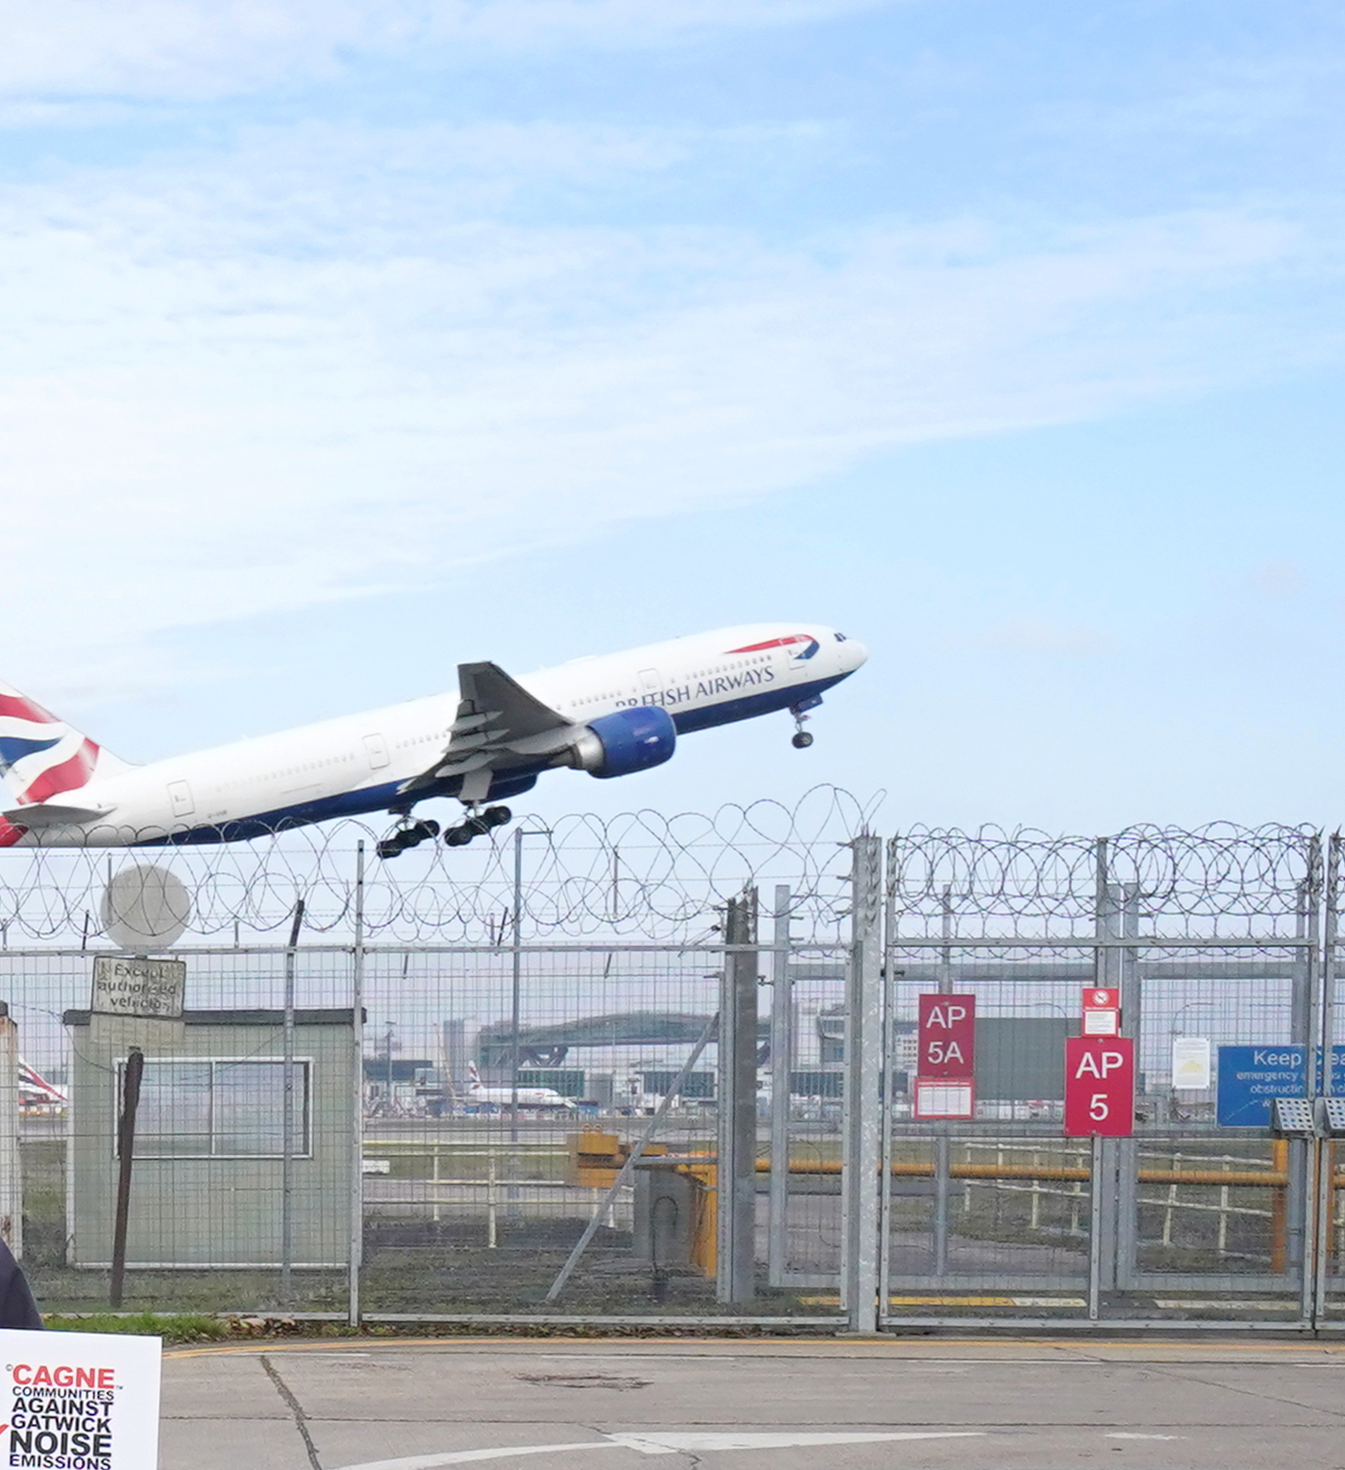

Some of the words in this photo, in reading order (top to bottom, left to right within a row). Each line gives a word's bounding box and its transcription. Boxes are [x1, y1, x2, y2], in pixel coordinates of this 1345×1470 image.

[695, 665, 774, 699] AIRWAYS
[926, 1005, 966, 1029] AP
[928, 1041, 964, 1064] 5A
[1254, 1050, 1302, 1069] Keep
[1075, 1051, 1124, 1079] AP
[1089, 1093, 1109, 1121] 5
[12, 1386, 114, 1401] COMMUNITIES
[12, 1397, 114, 1417] AGAINST
[11, 1414, 111, 1433] GATWICK
[10, 1430, 112, 1457] NOISE
[9, 1454, 111, 1470] EMISSIONS
